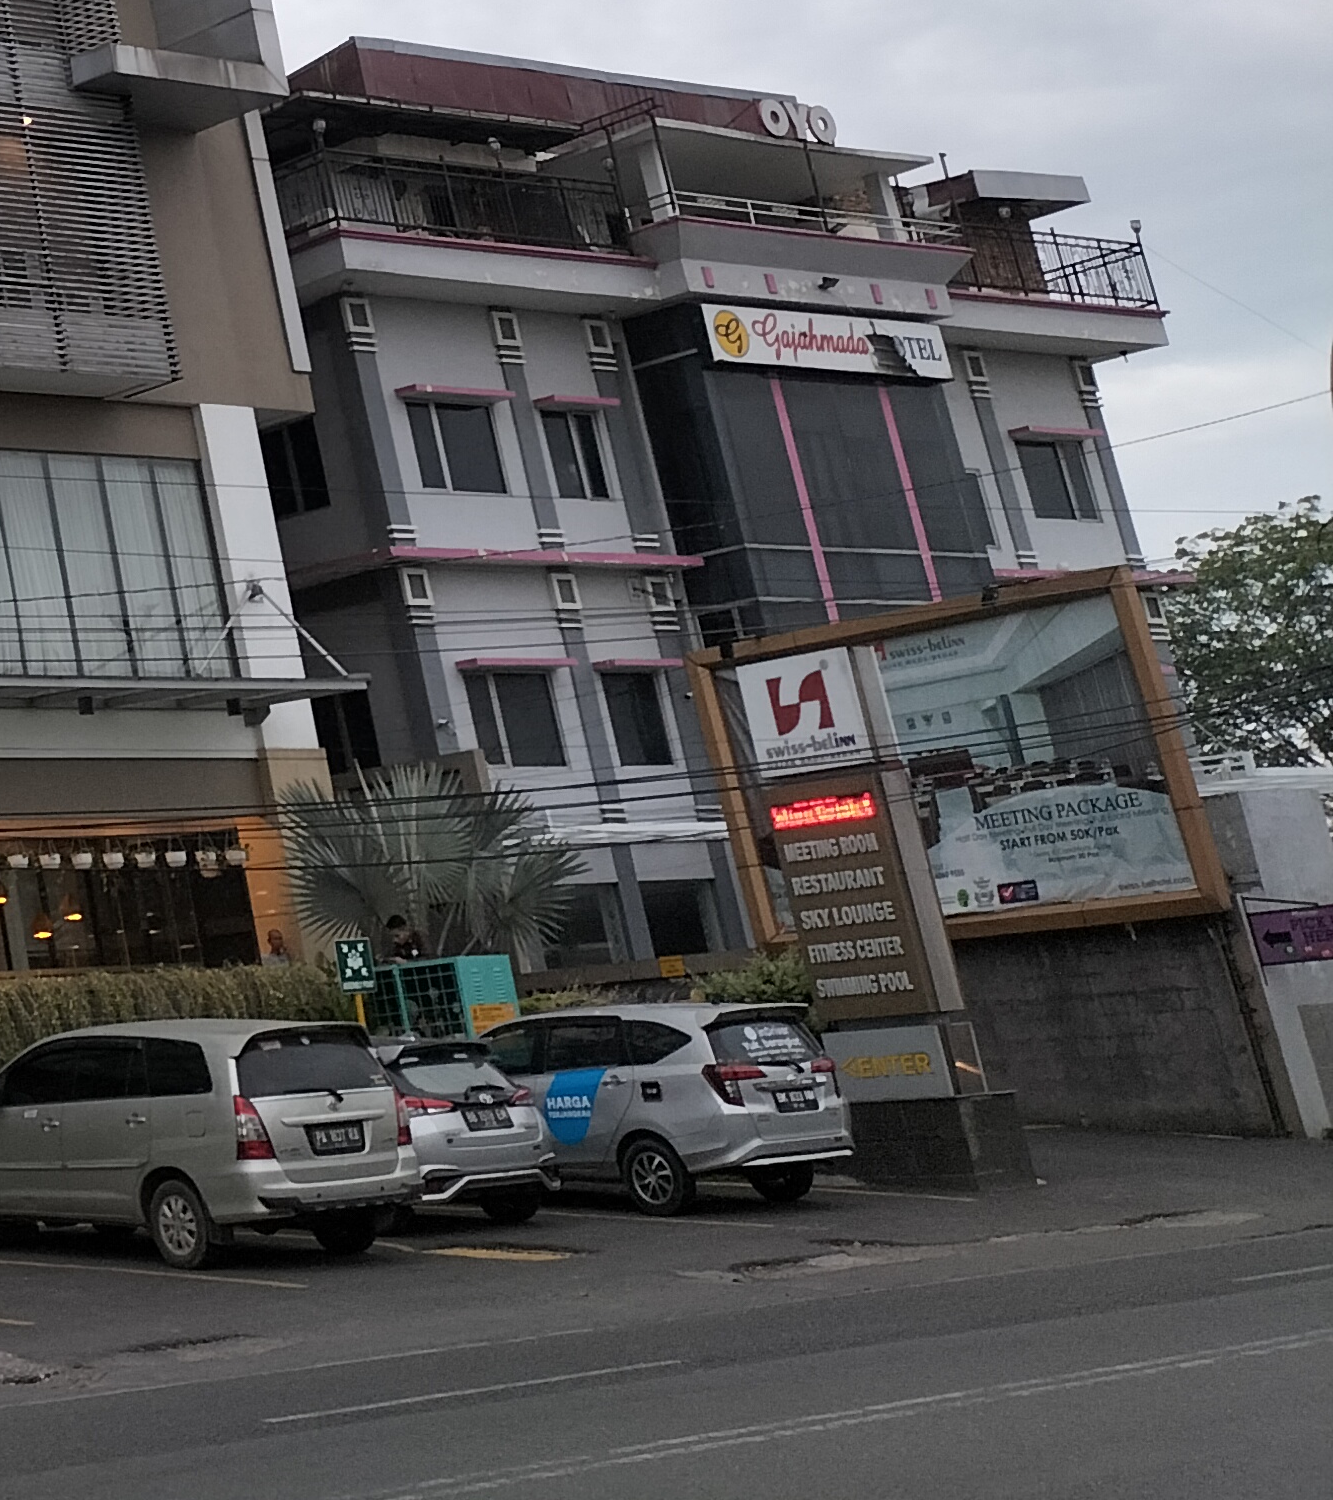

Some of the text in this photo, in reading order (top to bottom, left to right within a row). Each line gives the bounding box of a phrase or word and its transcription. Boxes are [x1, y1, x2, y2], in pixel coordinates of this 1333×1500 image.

[759, 99, 837, 145] OYO
[751, 313, 869, 362] Gajahmada
[974, 792, 1143, 832] MEETING PACKAGE
[783, 832, 879, 863] MEETING ROOM
[1000, 836, 1032, 851] START
[1034, 831, 1068, 846] FROM
[791, 867, 885, 897] RESTAURANT
[800, 900, 897, 930] SKY LOUNGE
[807, 936, 905, 964] FITNESS CENTER
[816, 970, 914, 998] SWIMMING POOL
[859, 1052, 932, 1078] ENTER
[546, 1095, 591, 1110] HARGA
